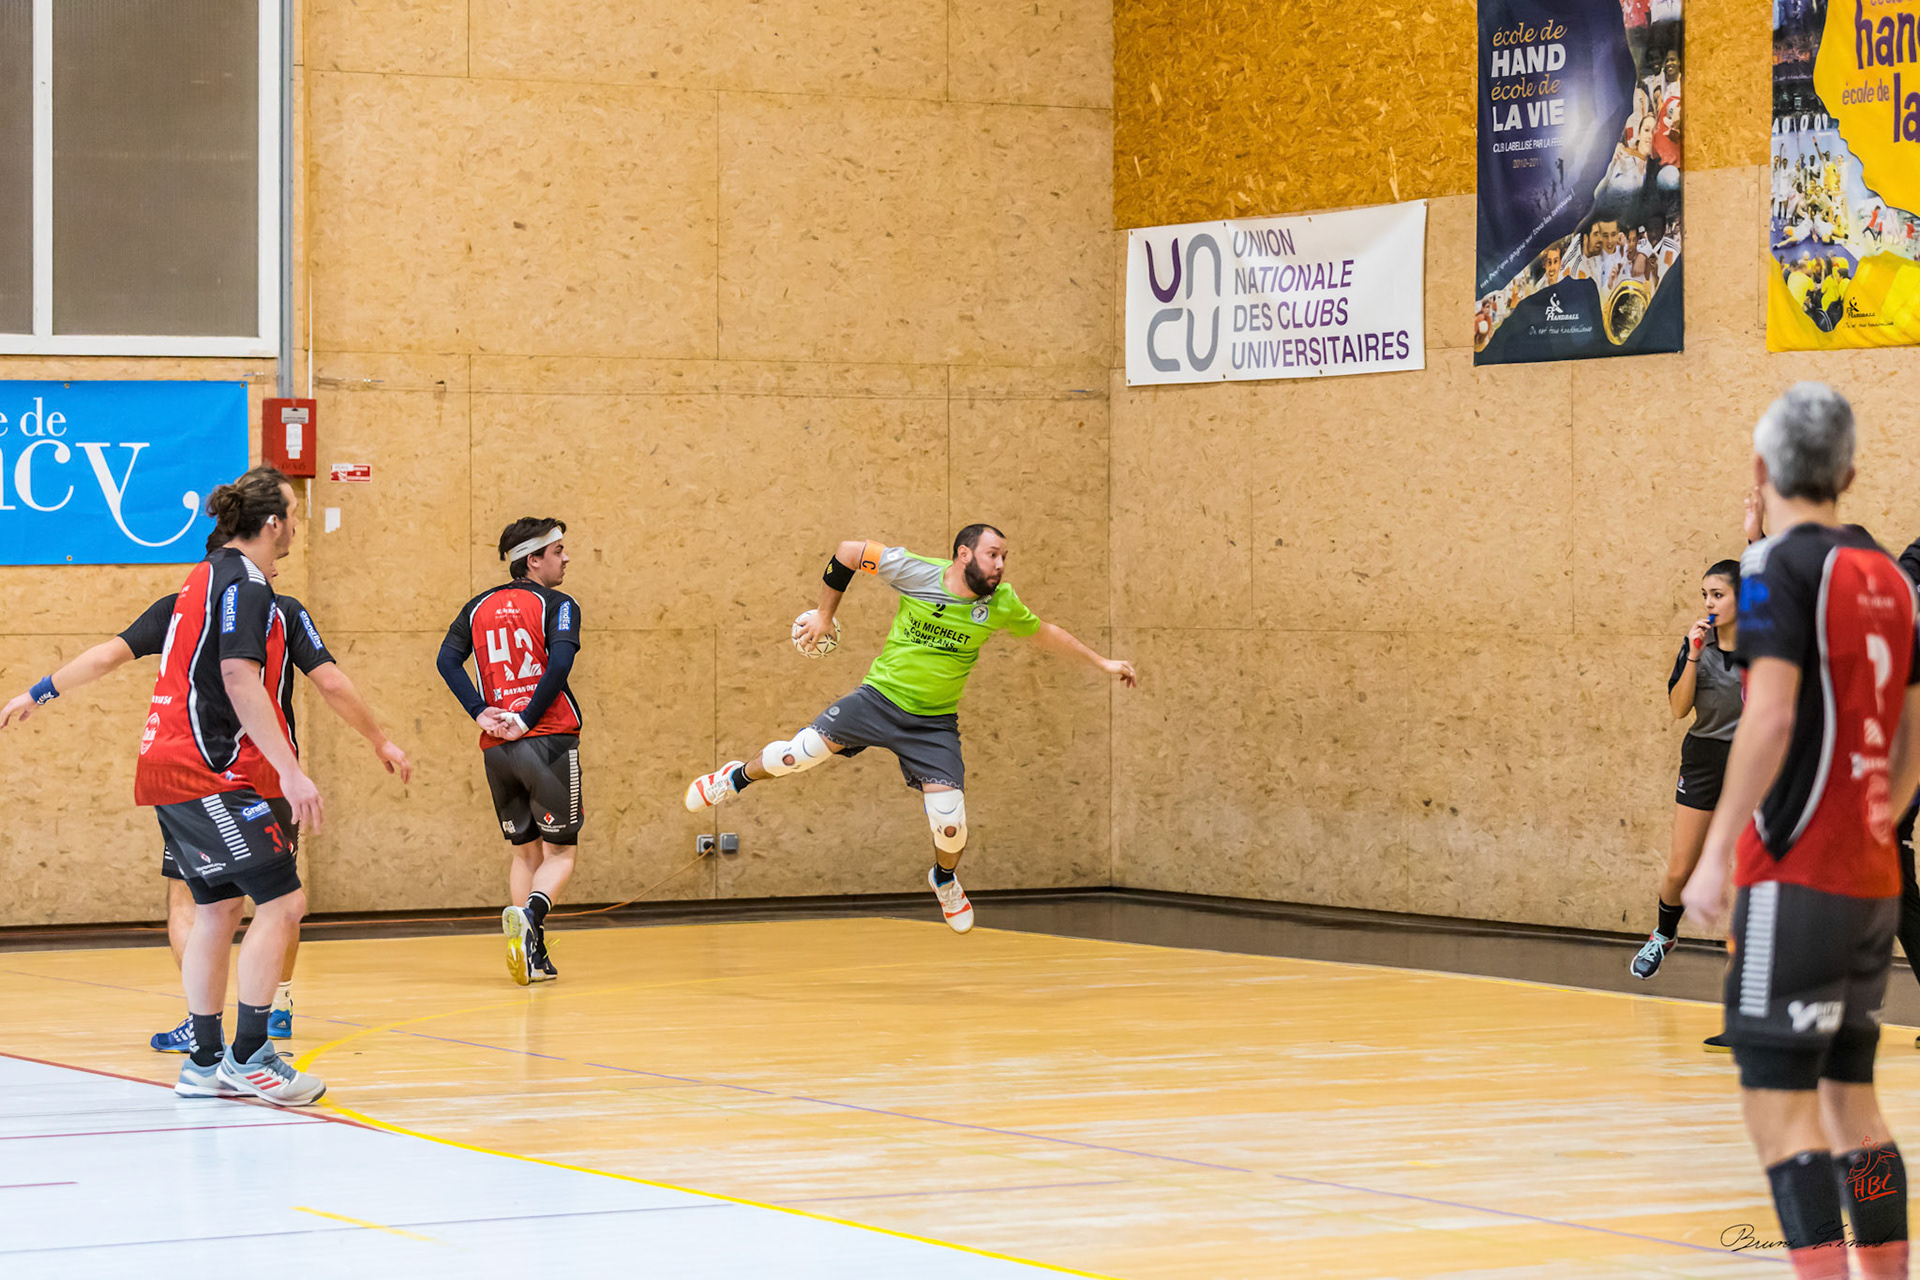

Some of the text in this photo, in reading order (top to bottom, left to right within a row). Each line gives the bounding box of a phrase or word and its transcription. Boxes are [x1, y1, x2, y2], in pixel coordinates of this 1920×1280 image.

[1493, 19, 1568, 47] école de
[1855, 0, 1920, 70] han
[1491, 43, 1567, 78] HAND
[1491, 73, 1561, 102] école de
[1842, 78, 1890, 105] école de
[1493, 99, 1565, 132] LA VIE
[1233, 228, 1296, 259] UNION
[1234, 259, 1355, 296] NATIONALE
[1234, 297, 1349, 333] DES CLUBS
[1232, 330, 1410, 371] UNIVERSITAIRES
[19, 397, 67, 437] de
[862, 560, 876, 570] C
[225, 585, 237, 632] Grand Est
[932, 603, 947, 618] 2
[910, 627, 955, 650] CONFLANS
[922, 622, 971, 645] MICHELET
[486, 627, 542, 682] 42
